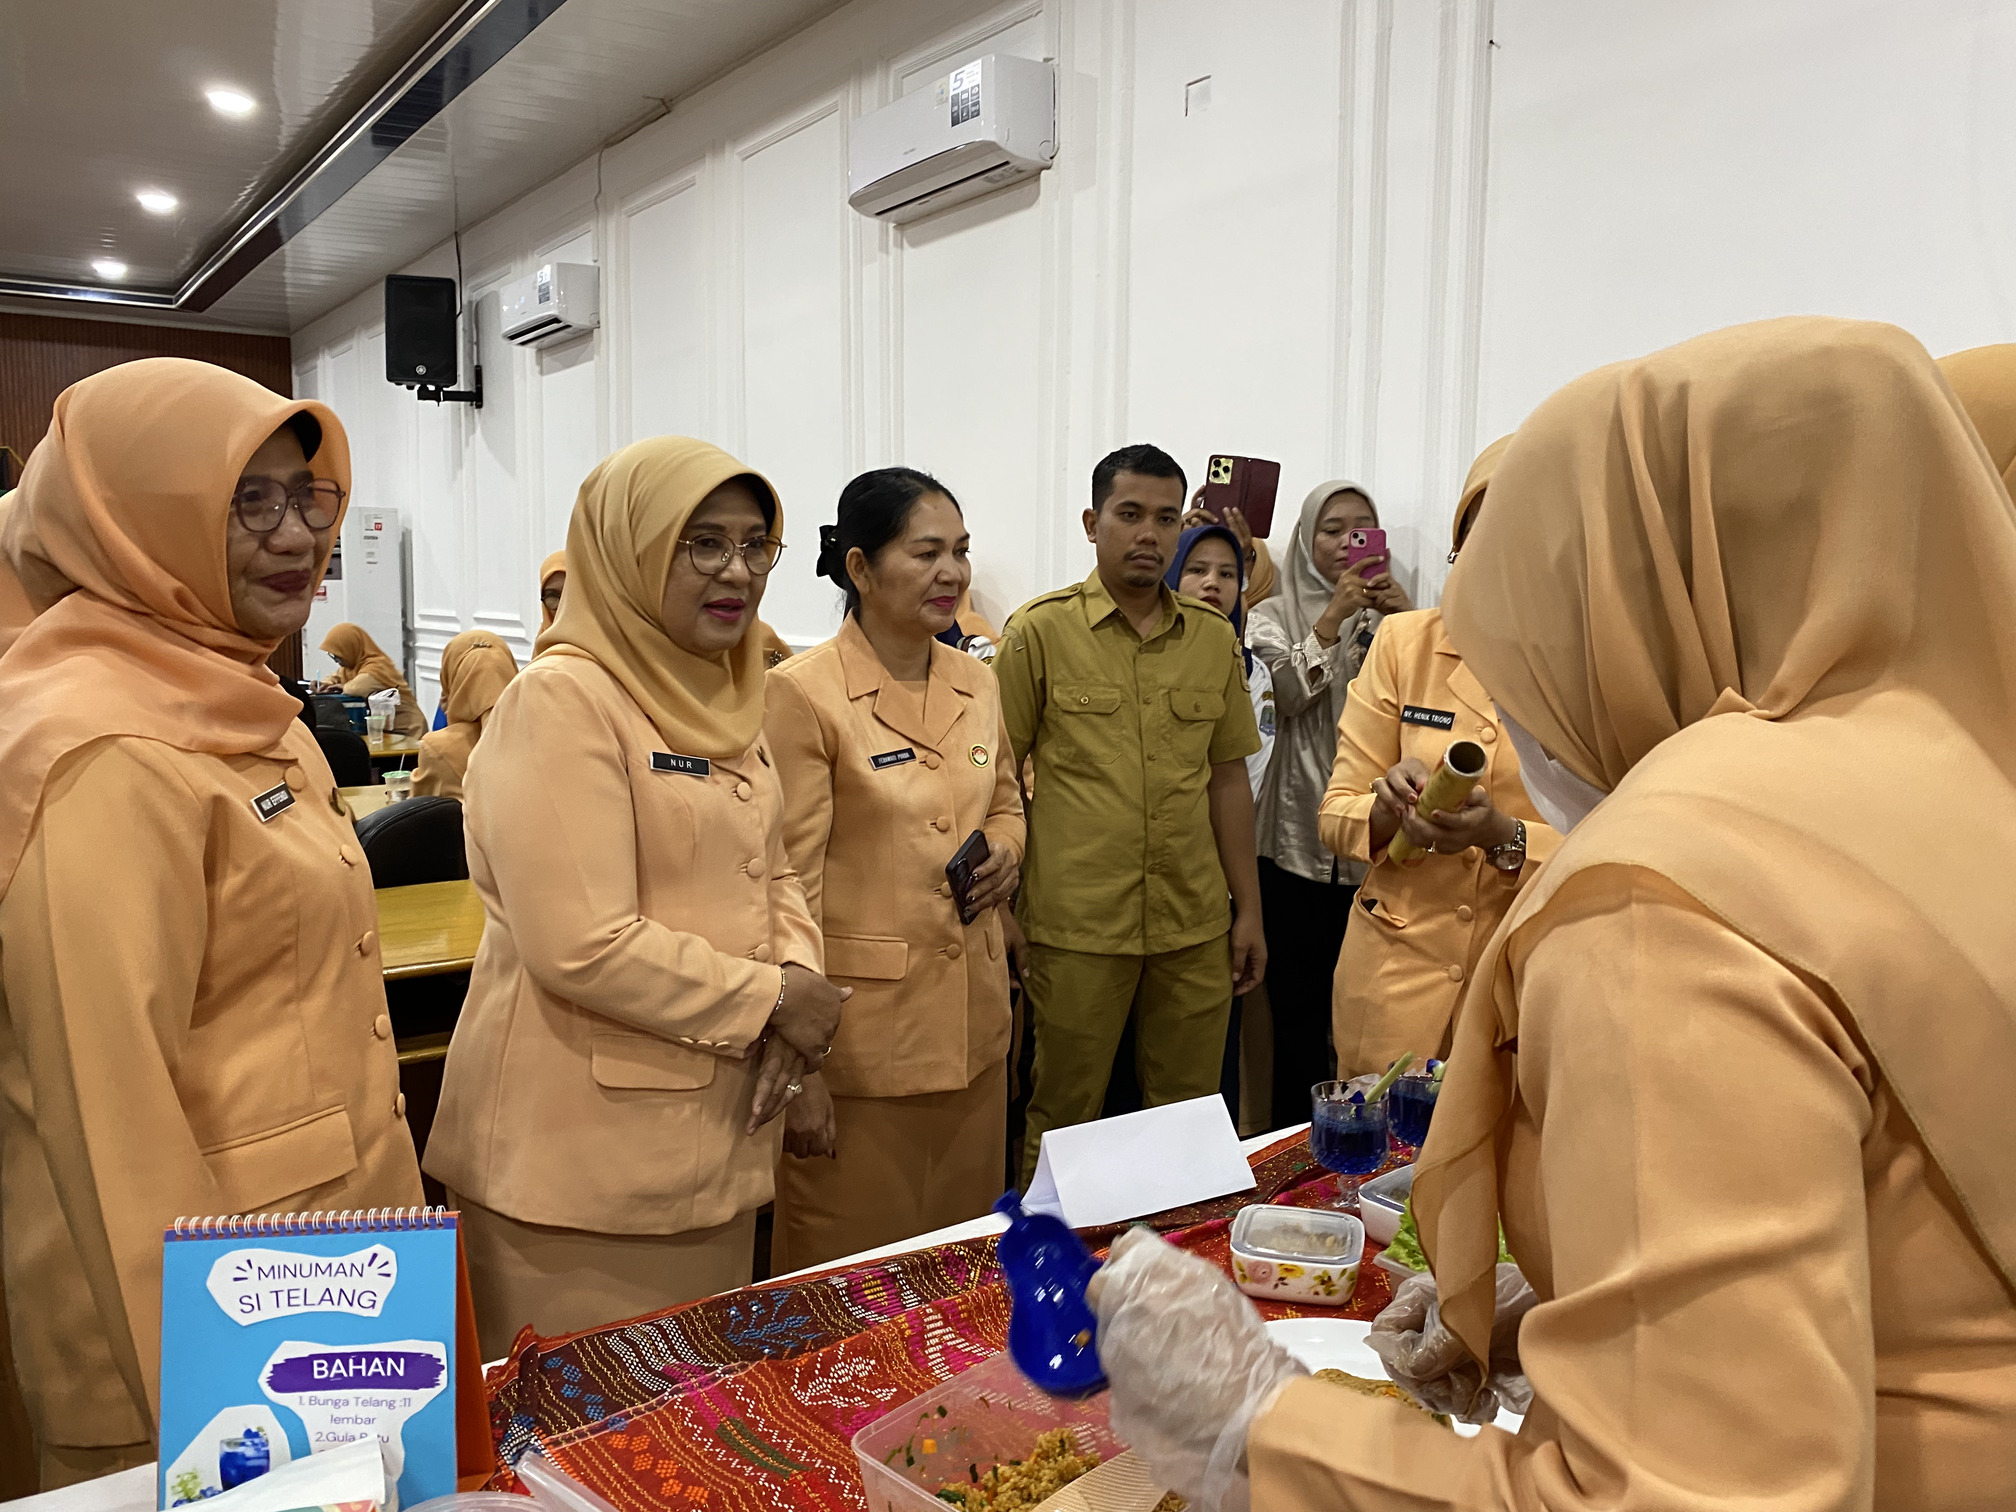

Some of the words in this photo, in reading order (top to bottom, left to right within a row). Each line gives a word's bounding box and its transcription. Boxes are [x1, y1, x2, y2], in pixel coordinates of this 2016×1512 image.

[952, 69, 966, 92] 5
[670, 758, 693, 769] NUR
[257, 1262, 364, 1281] MINUMAN
[238, 1292, 262, 1315] SI
[270, 1287, 378, 1310] TELANG
[312, 1357, 405, 1380] BAHAN
[308, 1395, 350, 1409] Bunga
[353, 1396, 396, 1411] Telang
[330, 1414, 377, 1425] lembar
